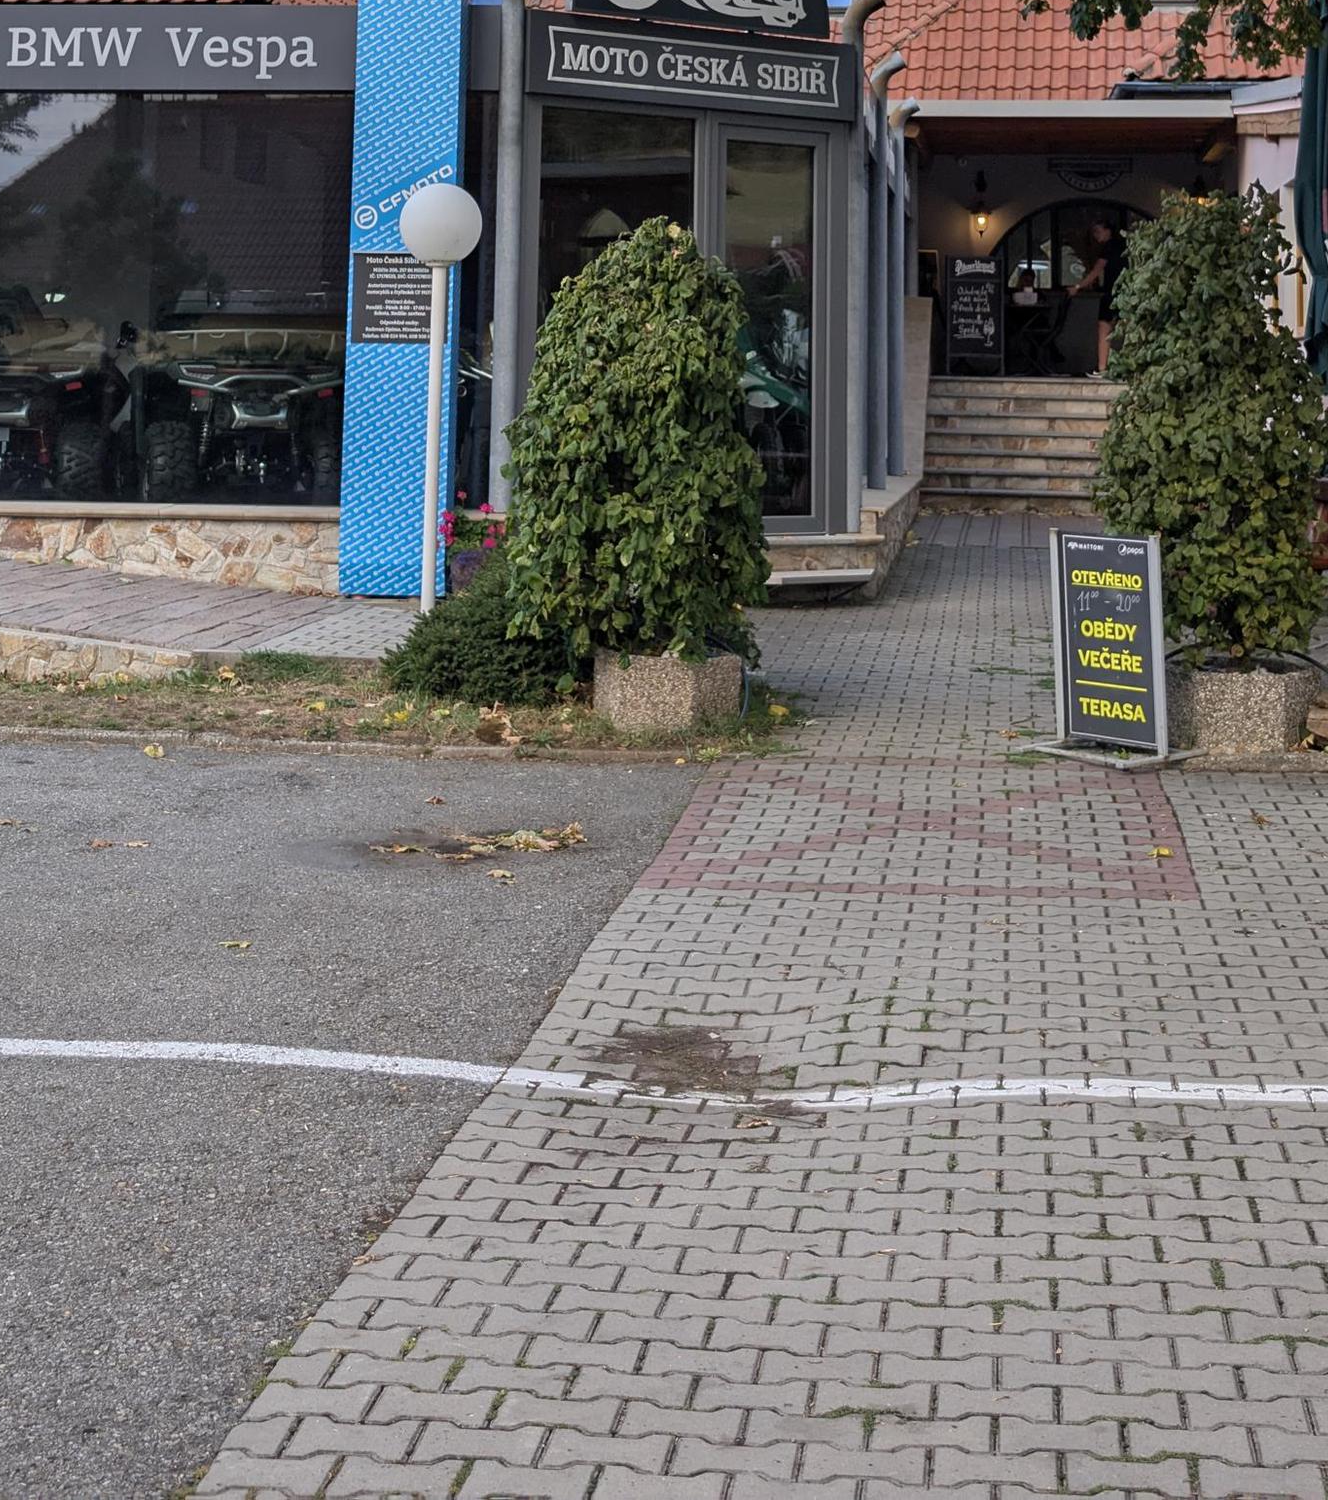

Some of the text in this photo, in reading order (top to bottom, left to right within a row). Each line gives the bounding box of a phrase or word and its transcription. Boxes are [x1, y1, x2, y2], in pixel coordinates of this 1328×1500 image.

[6, 27, 318, 80] BMW Vespa
[561, 42, 827, 96] MOTO ČESKÁ SIBIŘ
[378, 164, 453, 213] CFMOTO
[366, 256, 383, 264] Moto
[384, 255, 403, 264] Česká
[1072, 569, 1143, 589] OTEVŘENO
[1080, 617, 1137, 643] OBĚDY
[1077, 647, 1143, 674] VEČEŘE
[1079, 696, 1147, 723] TERASA
